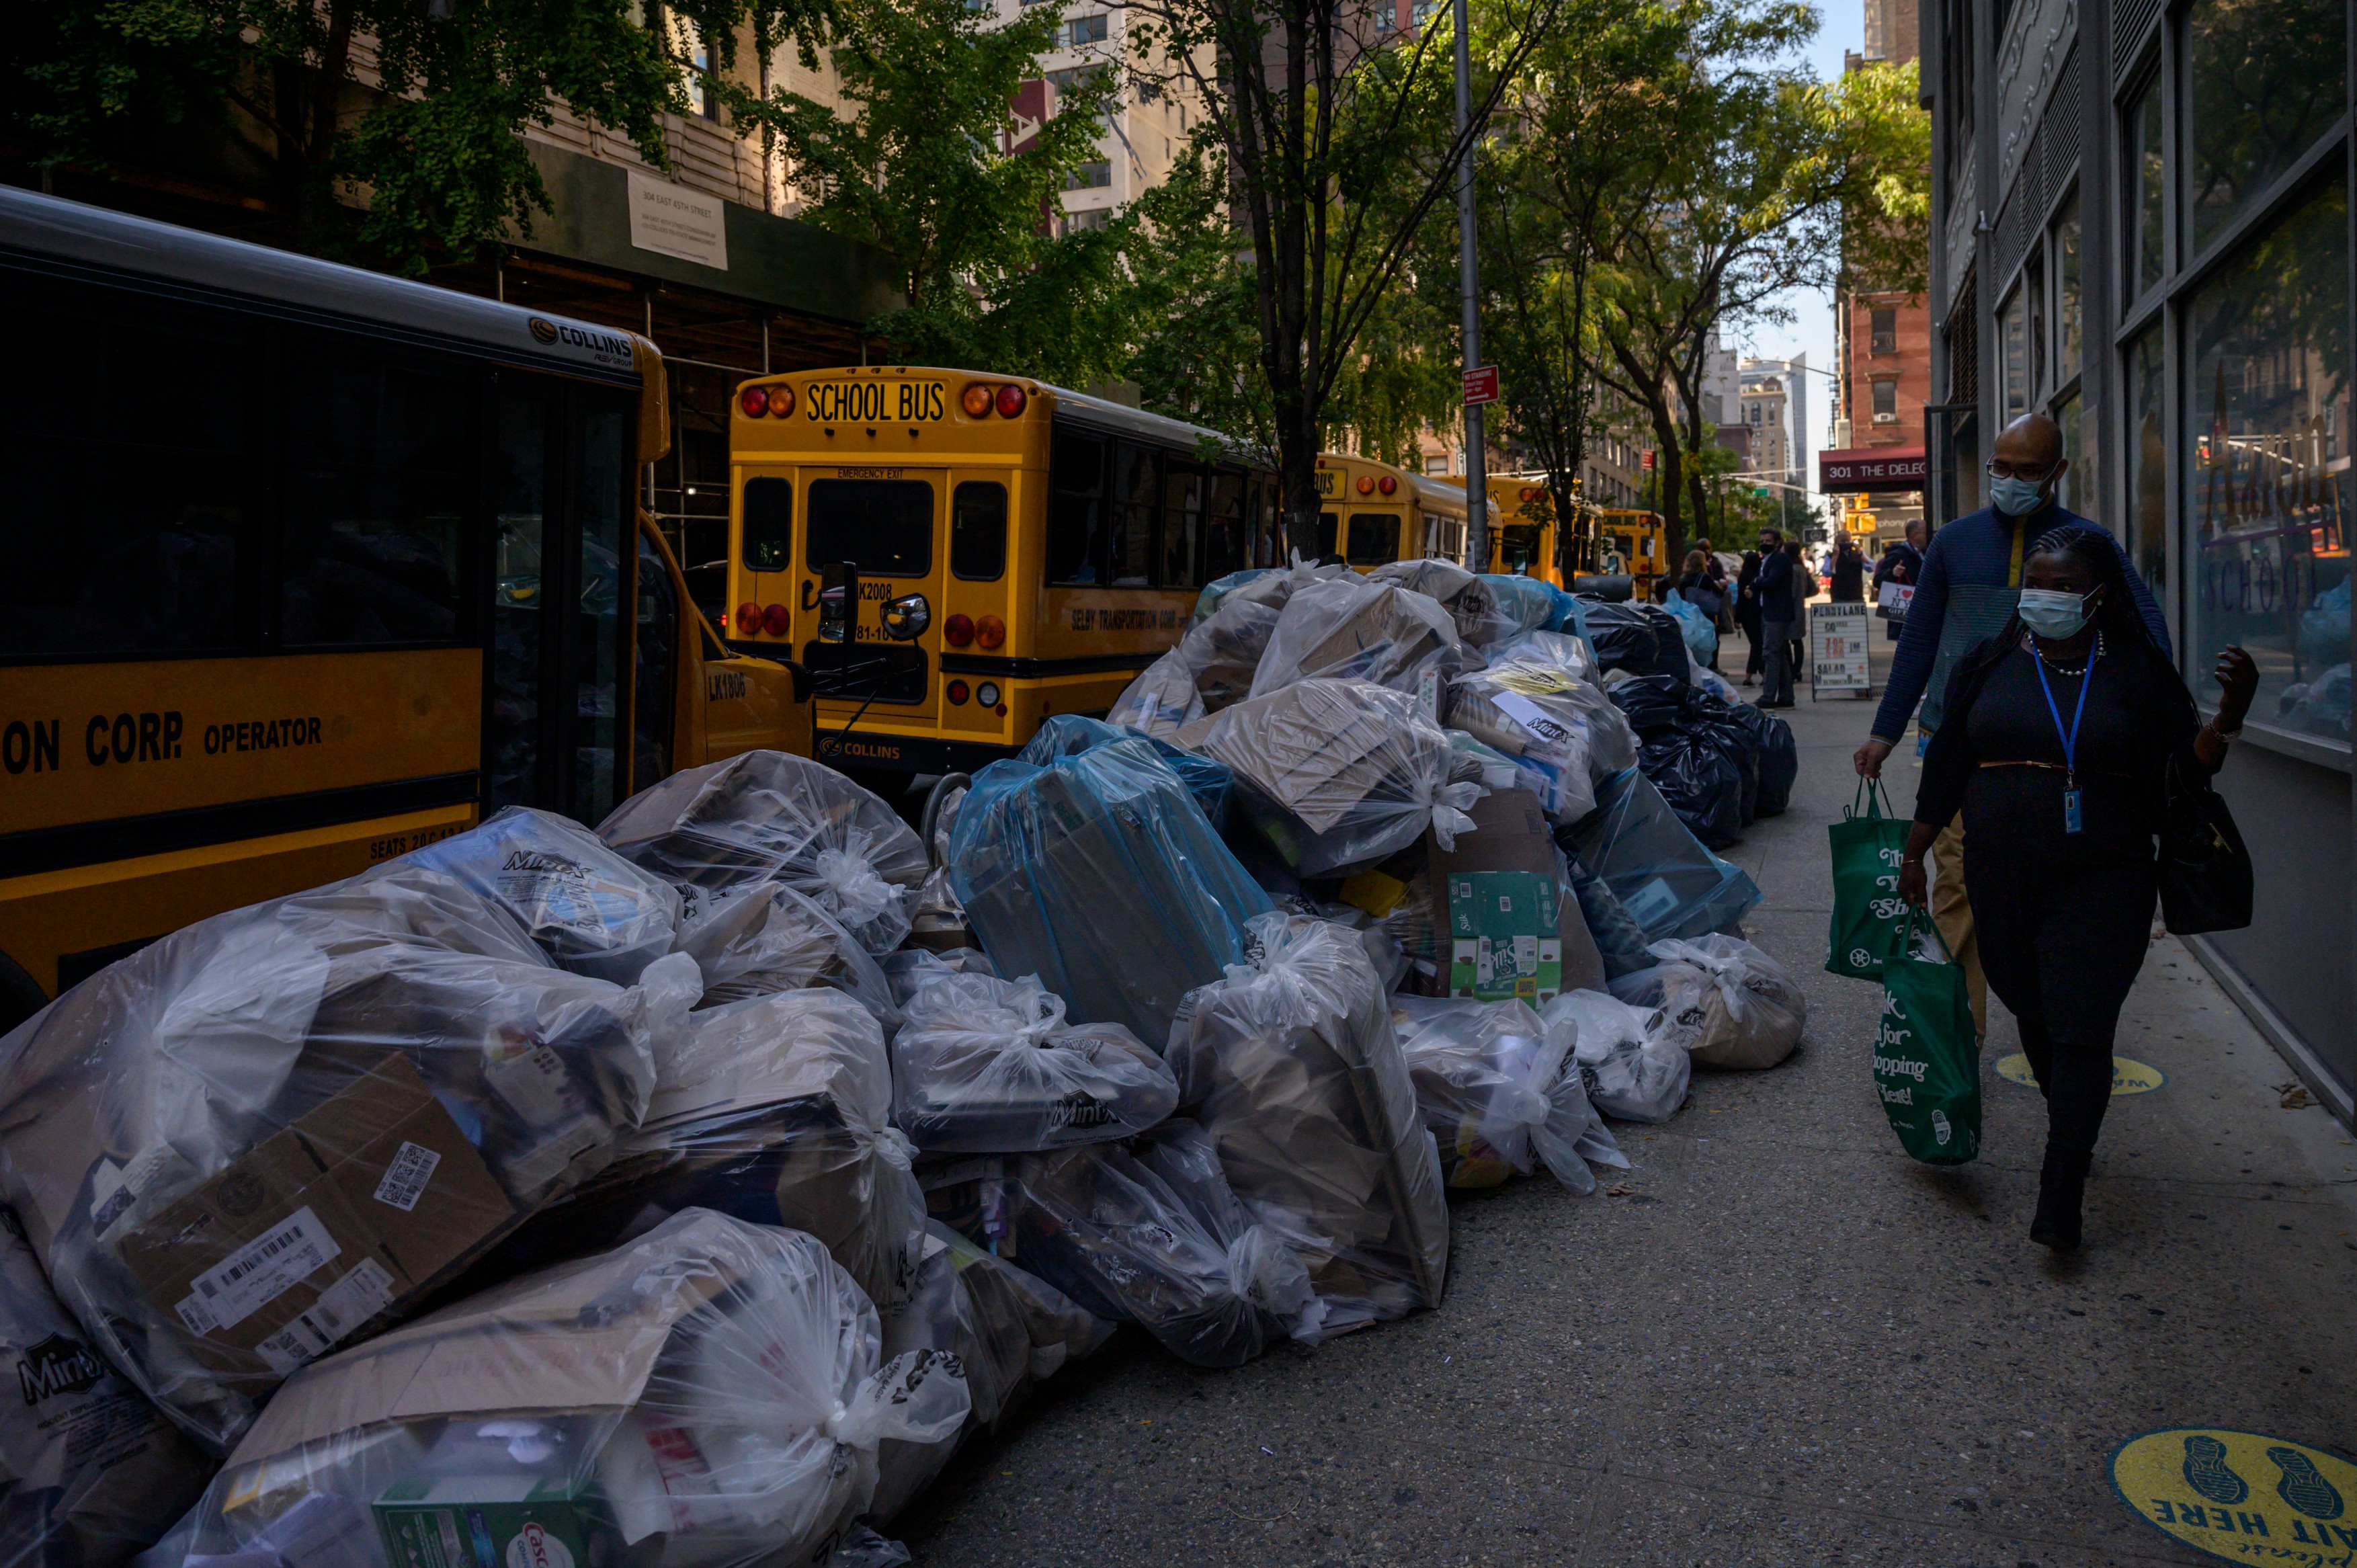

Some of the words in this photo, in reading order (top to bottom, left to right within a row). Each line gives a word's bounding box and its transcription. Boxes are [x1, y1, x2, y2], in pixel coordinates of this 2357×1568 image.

[643, 190, 655, 202] 304
[656, 194, 671, 206] EAST
[673, 200, 690, 212] 45TH
[690, 204, 712, 219] STREET
[559, 326, 632, 358] COLLINS
[594, 354, 616, 364] REV
[613, 358, 632, 368] GROUP
[1471, 370, 1492, 380] STANDING
[807, 382, 891, 422] SCHOOL
[899, 382, 944, 421] BUS
[837, 468, 886, 479] EMERGENCY
[887, 468, 904, 479] EXIT
[1829, 466, 1852, 478] 301
[1860, 464, 1885, 477] THE
[859, 583, 892, 600] K2008
[2207, 551, 2323, 613] SCHOOL
[1072, 609, 1095, 631] SELBY
[1100, 609, 1157, 630] TRANSPORTATION
[708, 672, 745, 702] LK1806
[0, 720, 60, 776] ON
[86, 710, 183, 767] CORP.
[204, 716, 322, 755] OPERATOR
[844, 741, 901, 759] COLLINS
[370, 837, 407, 860] SEATS
[1458, 913, 1471, 932] Silk
[1490, 944, 1516, 969] Silk
[1879, 1022, 1911, 1048] for
[1872, 1048, 1929, 1083] hopping
[37, 1411, 69, 1430] RODENT
[2151, 1499, 2270, 1538] HERE
[522, 1522, 550, 1568] Casc
[2291, 1518, 2357, 1551] AIT
[2237, 1541, 2354, 1568] please
